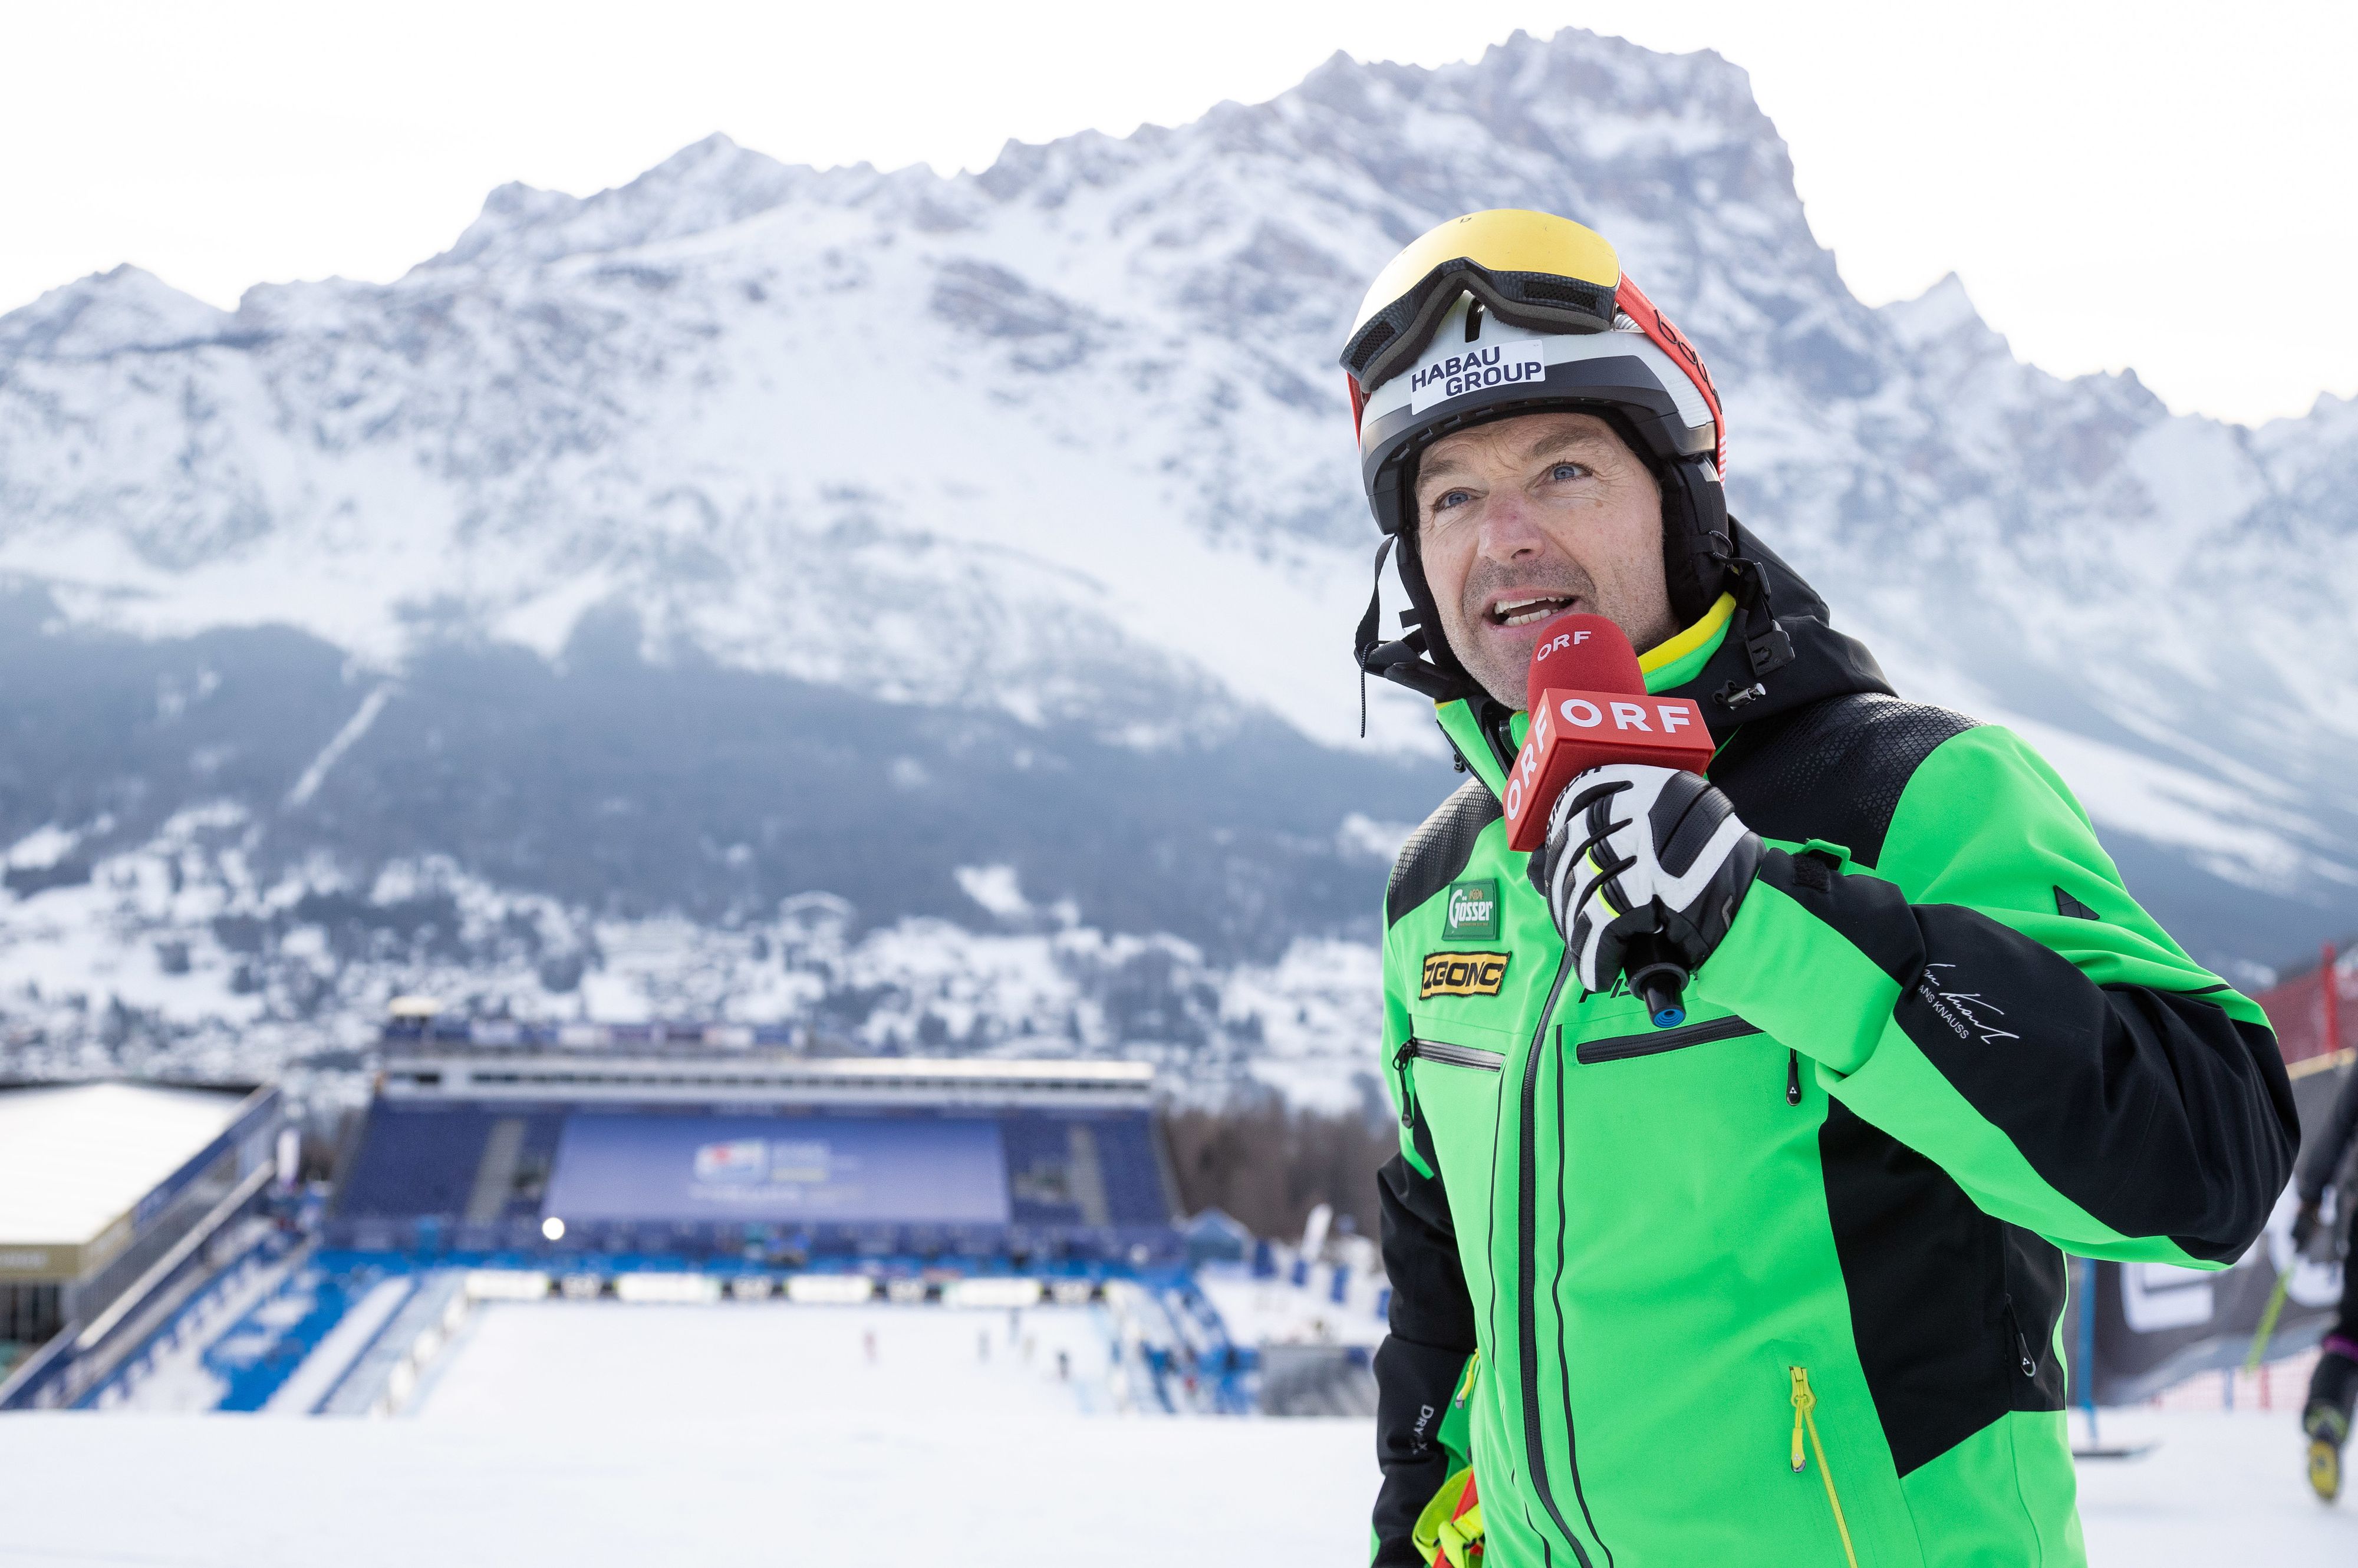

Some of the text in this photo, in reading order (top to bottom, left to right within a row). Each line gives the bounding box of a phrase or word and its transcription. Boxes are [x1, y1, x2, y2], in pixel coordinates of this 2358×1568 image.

[1411, 346, 1500, 393] HABAU
[1445, 361, 1542, 397] GROUP
[1537, 631, 1592, 661] ORF
[1560, 699, 1690, 733] ORF
[1507, 704, 1547, 821] ORF
[1449, 888, 1493, 929] Gösser
[1424, 961, 1504, 990] ZGONC
[1918, 984, 1935, 1003] ANS
[1932, 1000, 1970, 1039] KNAUSS
